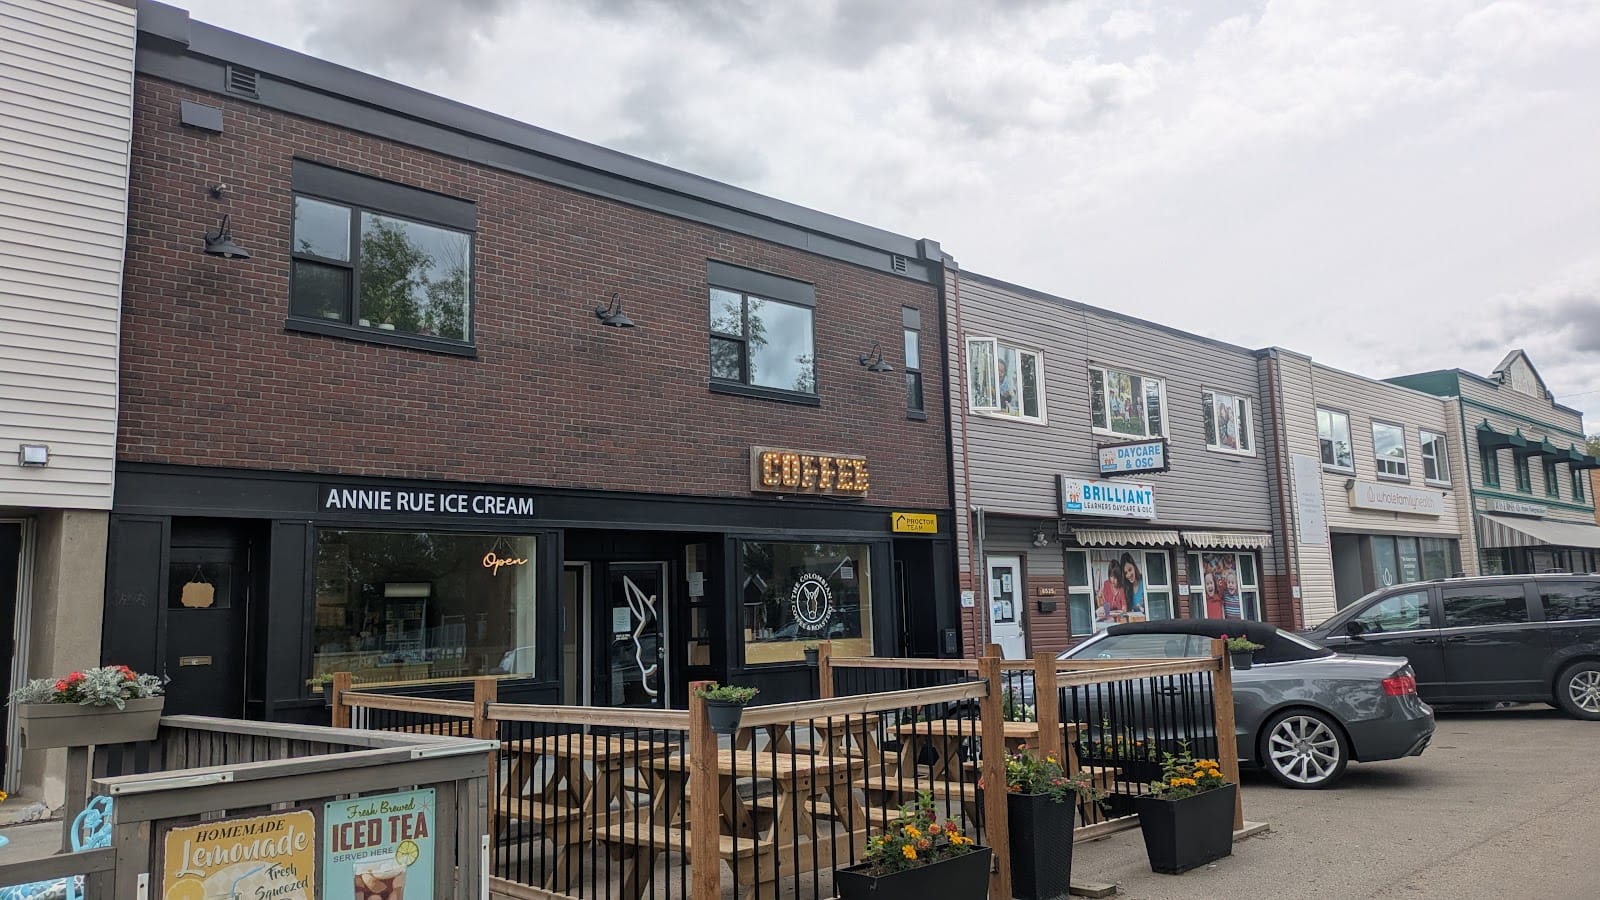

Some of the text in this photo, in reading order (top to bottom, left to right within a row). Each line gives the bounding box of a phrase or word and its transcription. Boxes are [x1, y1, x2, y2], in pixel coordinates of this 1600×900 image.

[1117, 445, 1160, 458] DAYCARE
[1125, 459, 1132, 469] &
[1135, 457, 1154, 468] OSC
[759, 450, 870, 491] COFFEE
[325, 488, 534, 516] ANNIE RUE ICE CREAM
[1083, 485, 1151, 505] BRILLIANT
[1083, 502, 1111, 510] LEARNERS
[1112, 503, 1136, 512] DAYCARE
[906, 517, 934, 526] PROCTOR
[482, 551, 528, 577] Open
[791, 581, 801, 599] THE
[799, 573, 833, 599] COLOMBIAN
[346, 797, 416, 819] Fresh Brewed
[196, 819, 286, 843] HOMEMADE
[332, 811, 429, 853] ICED TEA
[176, 825, 309, 878] Lemonade
[333, 846, 393, 863] SERVED HERE
[264, 862, 297, 881] Fresh
[254, 875, 309, 900] Squeezed
